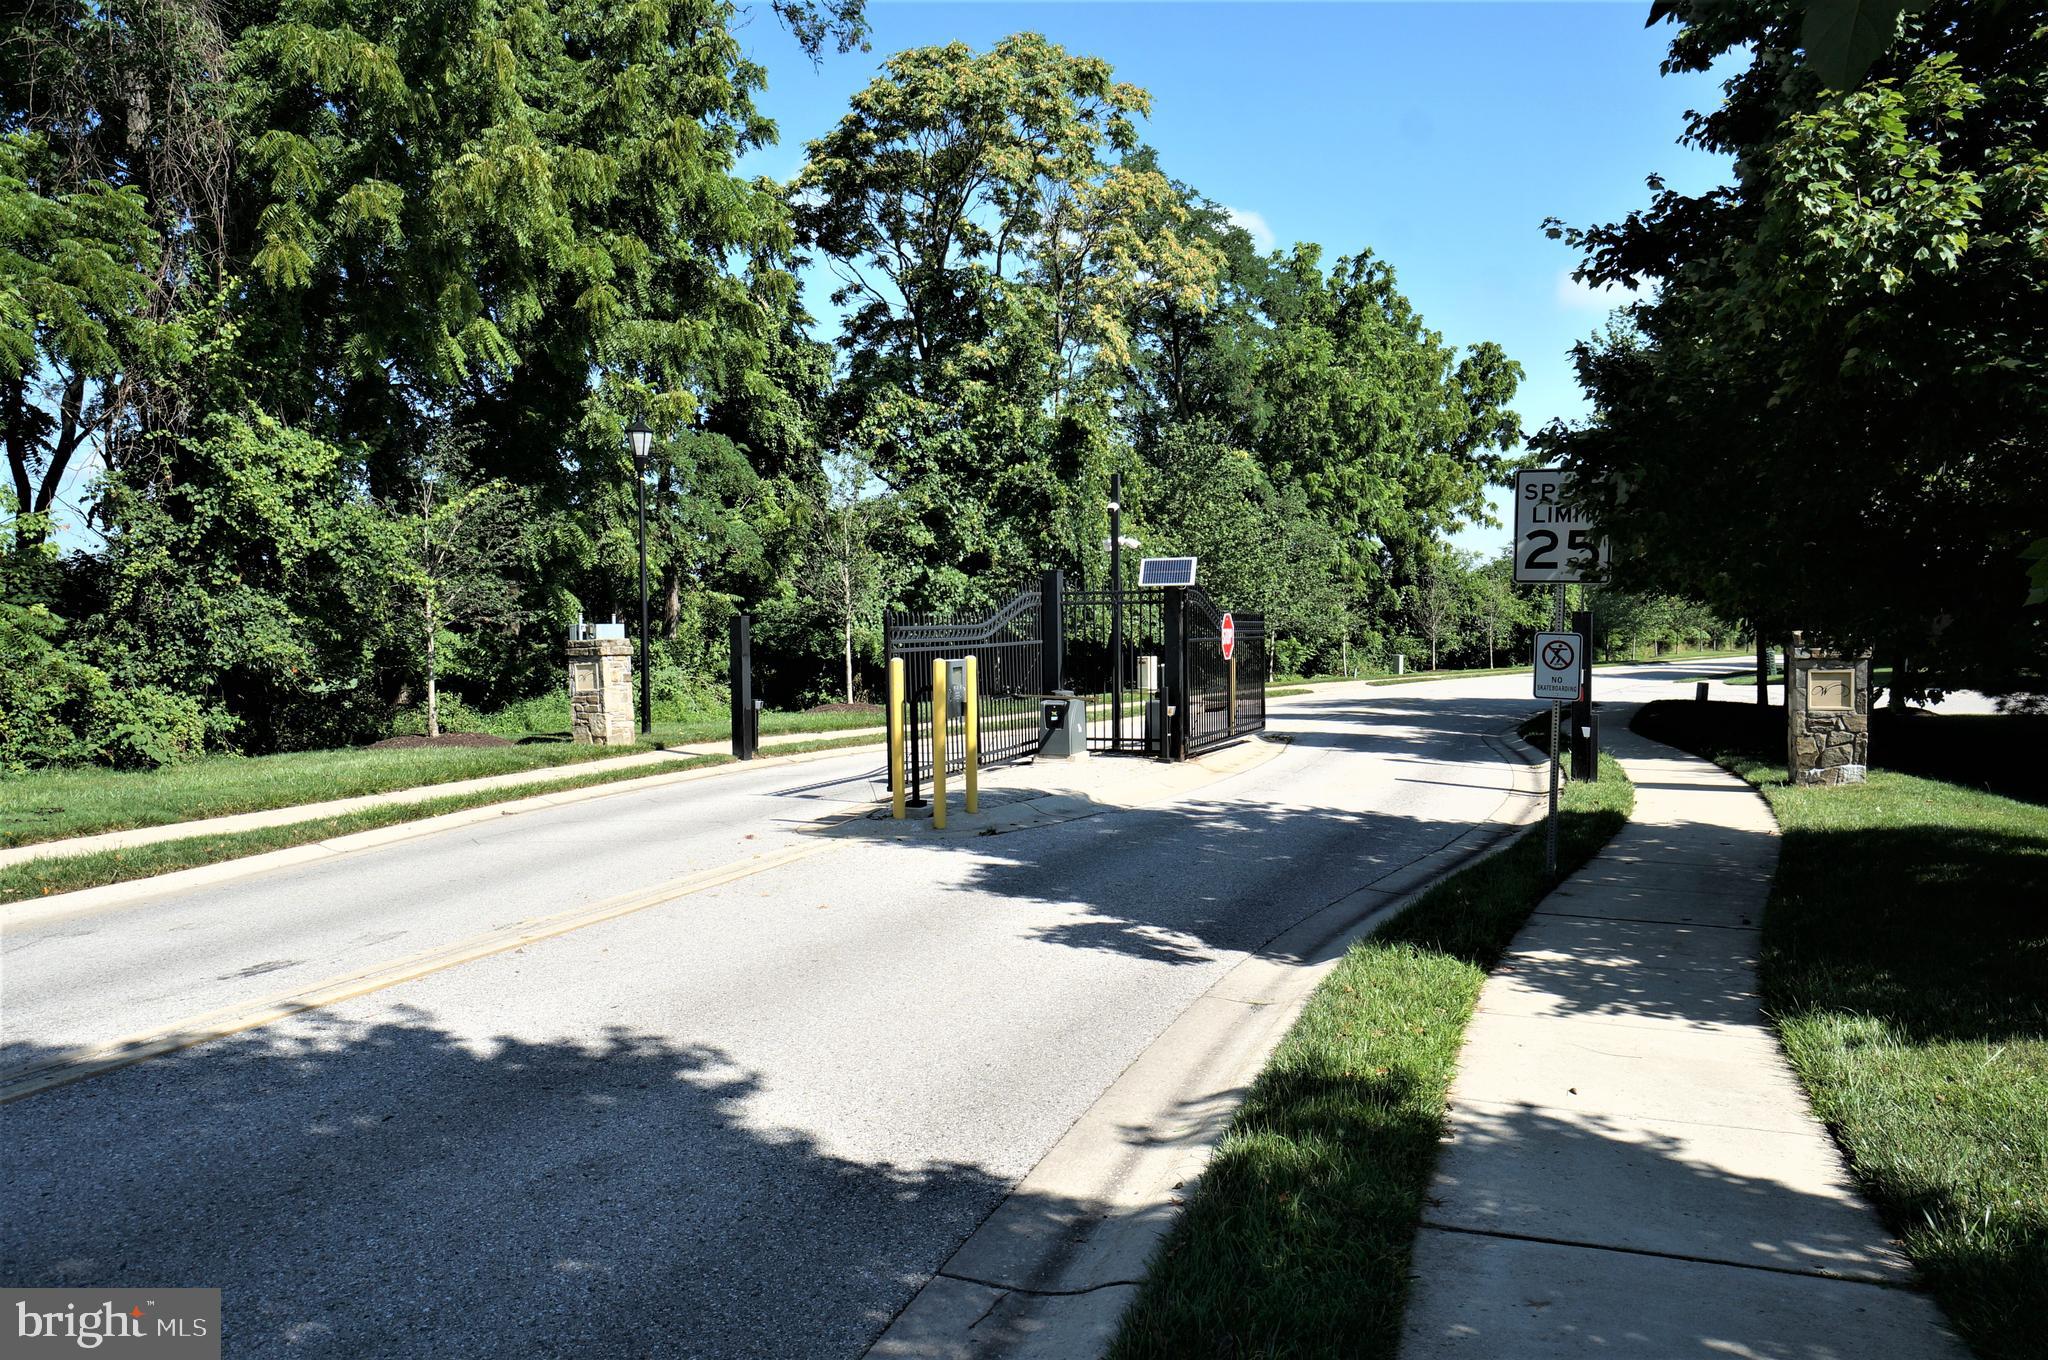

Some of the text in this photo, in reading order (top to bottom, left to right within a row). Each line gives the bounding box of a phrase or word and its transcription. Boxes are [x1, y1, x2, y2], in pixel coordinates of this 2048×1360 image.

[1524, 529, 1600, 570] 25
[1551, 676, 1563, 684] NO
[1536, 684, 1577, 693] SKATEBOARDING
